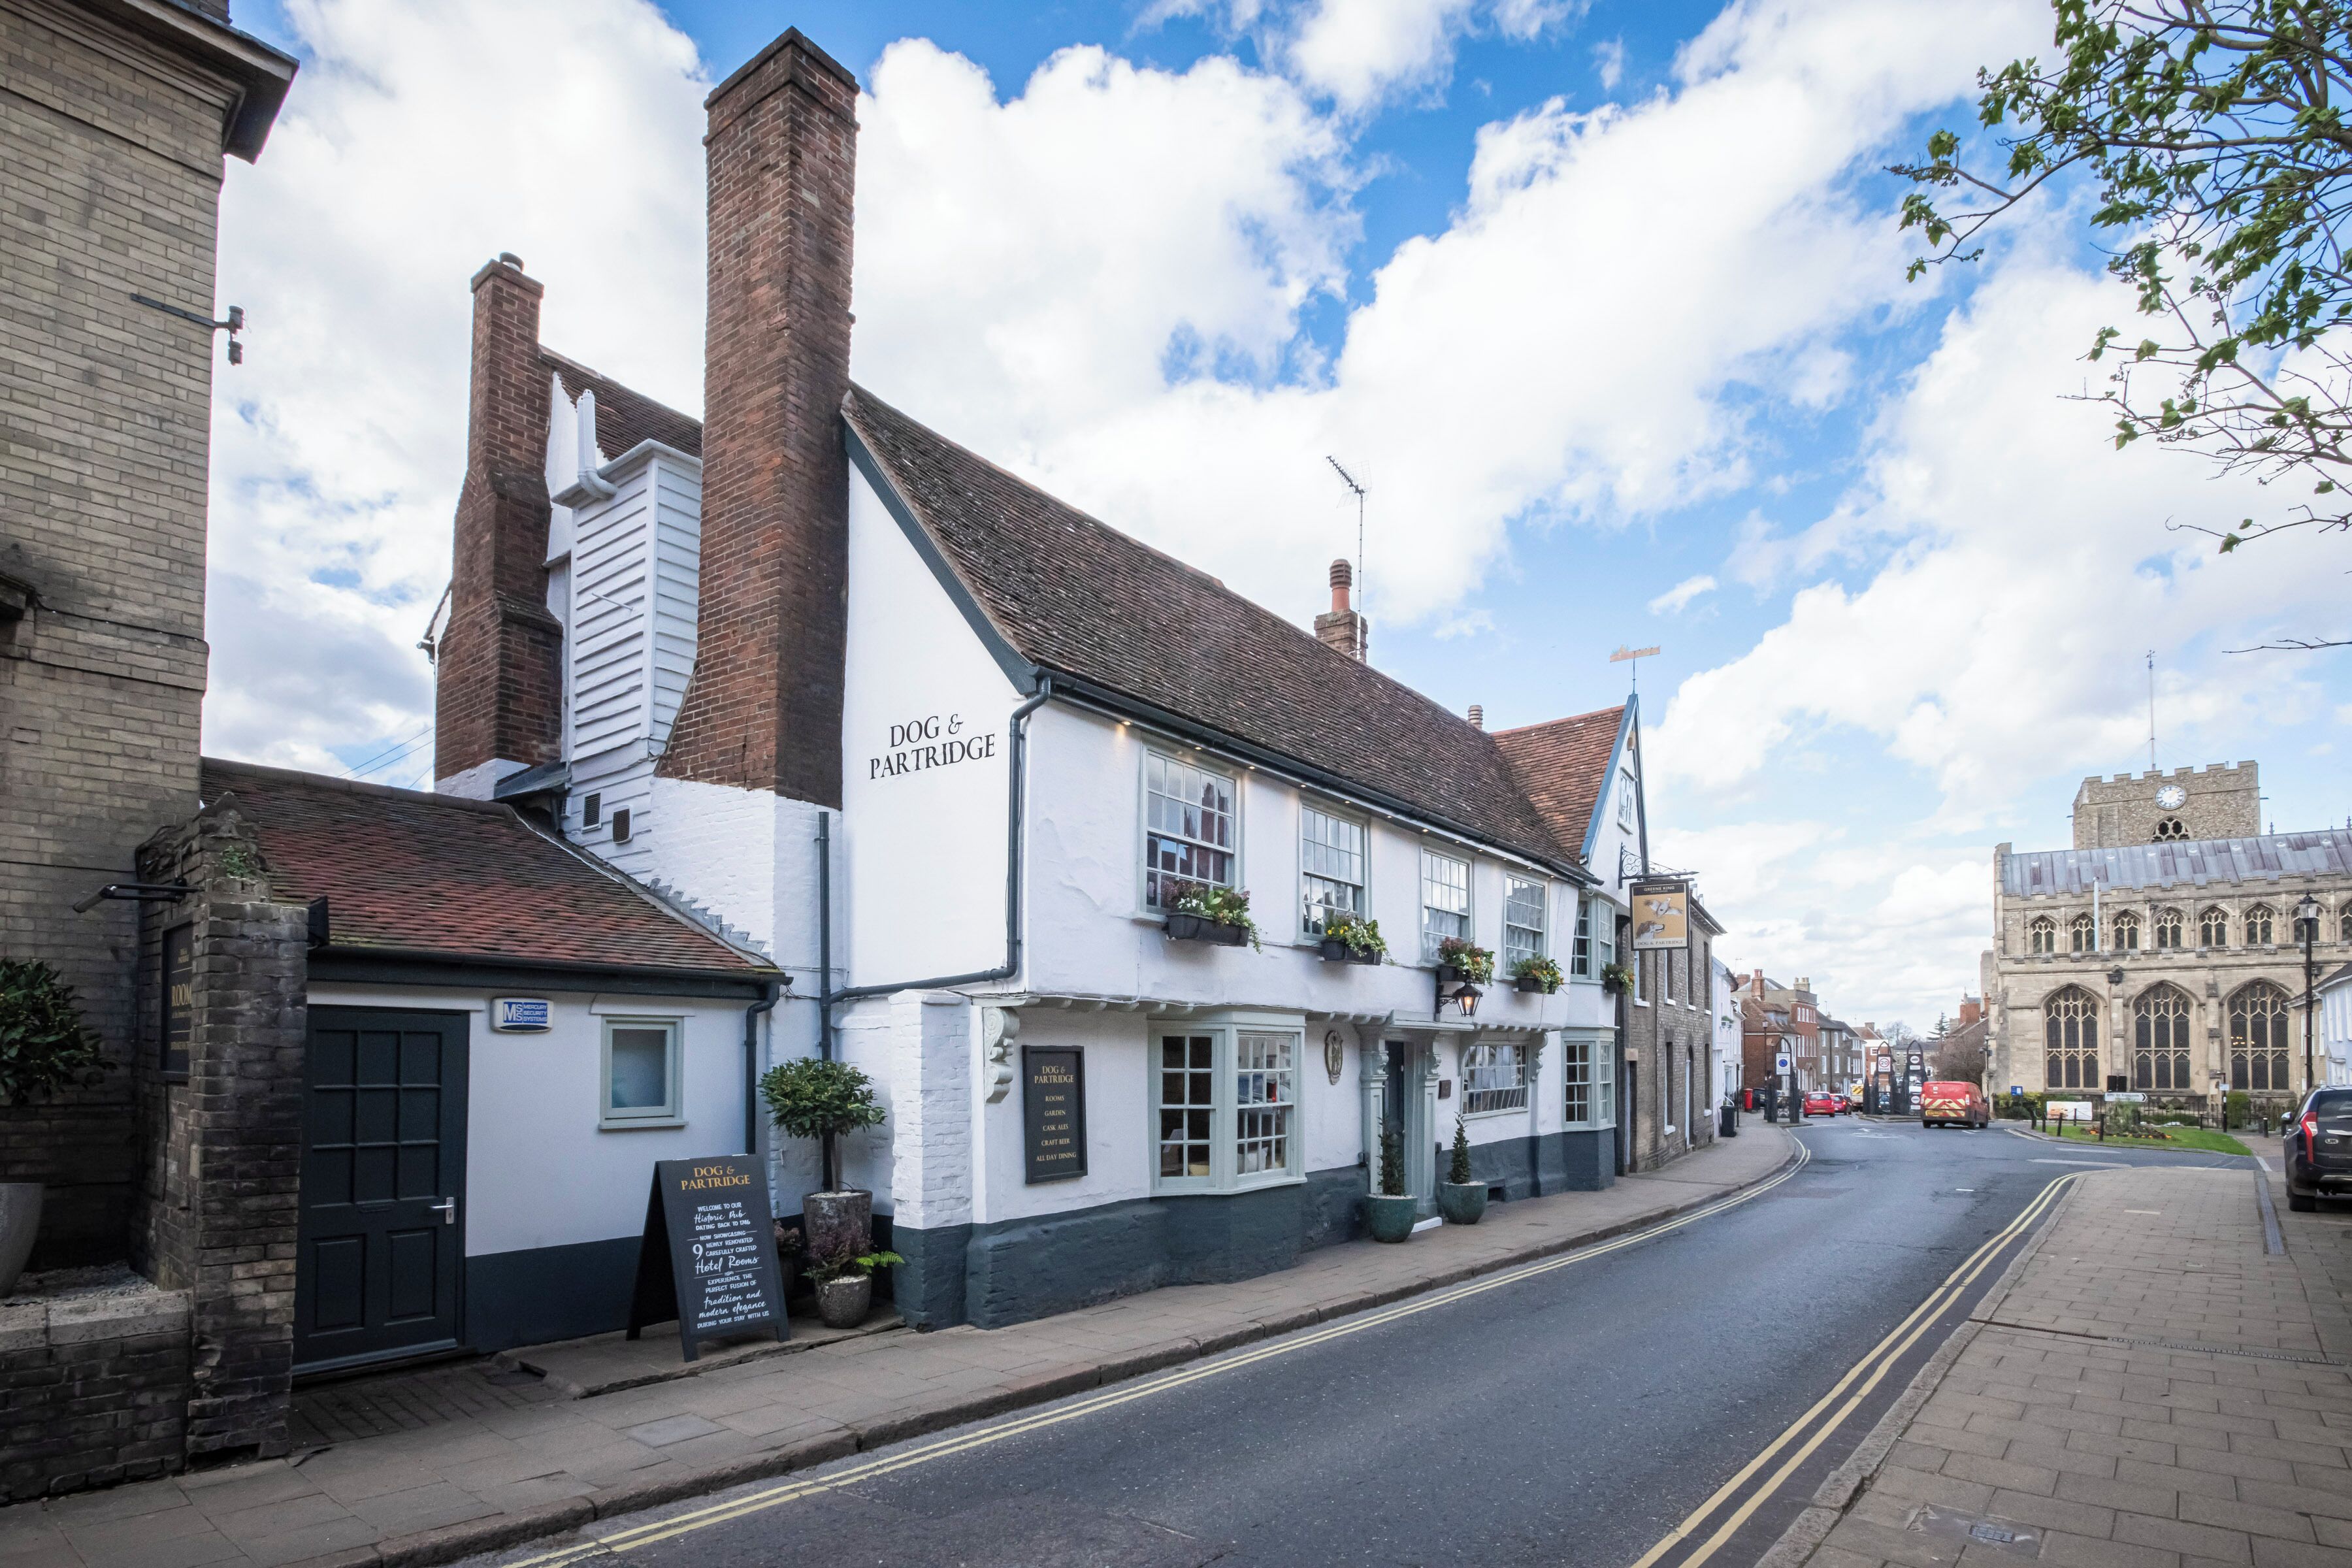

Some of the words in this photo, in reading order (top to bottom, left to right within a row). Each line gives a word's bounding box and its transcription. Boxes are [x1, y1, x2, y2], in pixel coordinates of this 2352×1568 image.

[890, 716, 939, 747] DOG
[948, 713, 964, 734] &
[870, 732, 995, 779] PARTRIDGE
[1034, 1075, 1074, 1083] PARTRIDGE
[694, 1166, 723, 1177] DOG
[681, 1175, 751, 1190] PARTRIDGE
[694, 1213, 725, 1224] Historic
[729, 1210, 746, 1219] Pub
[693, 1244, 703, 1260] 9
[725, 1237, 753, 1245] RENOVATED
[694, 1257, 723, 1274] Hotel
[728, 1256, 760, 1268] Rooms
[708, 1275, 740, 1285] EXPERIENCE
[704, 1294, 743, 1309] tradition
[746, 1290, 762, 1298] and
[699, 1308, 728, 1318] modern
[732, 1301, 766, 1314] elegance
